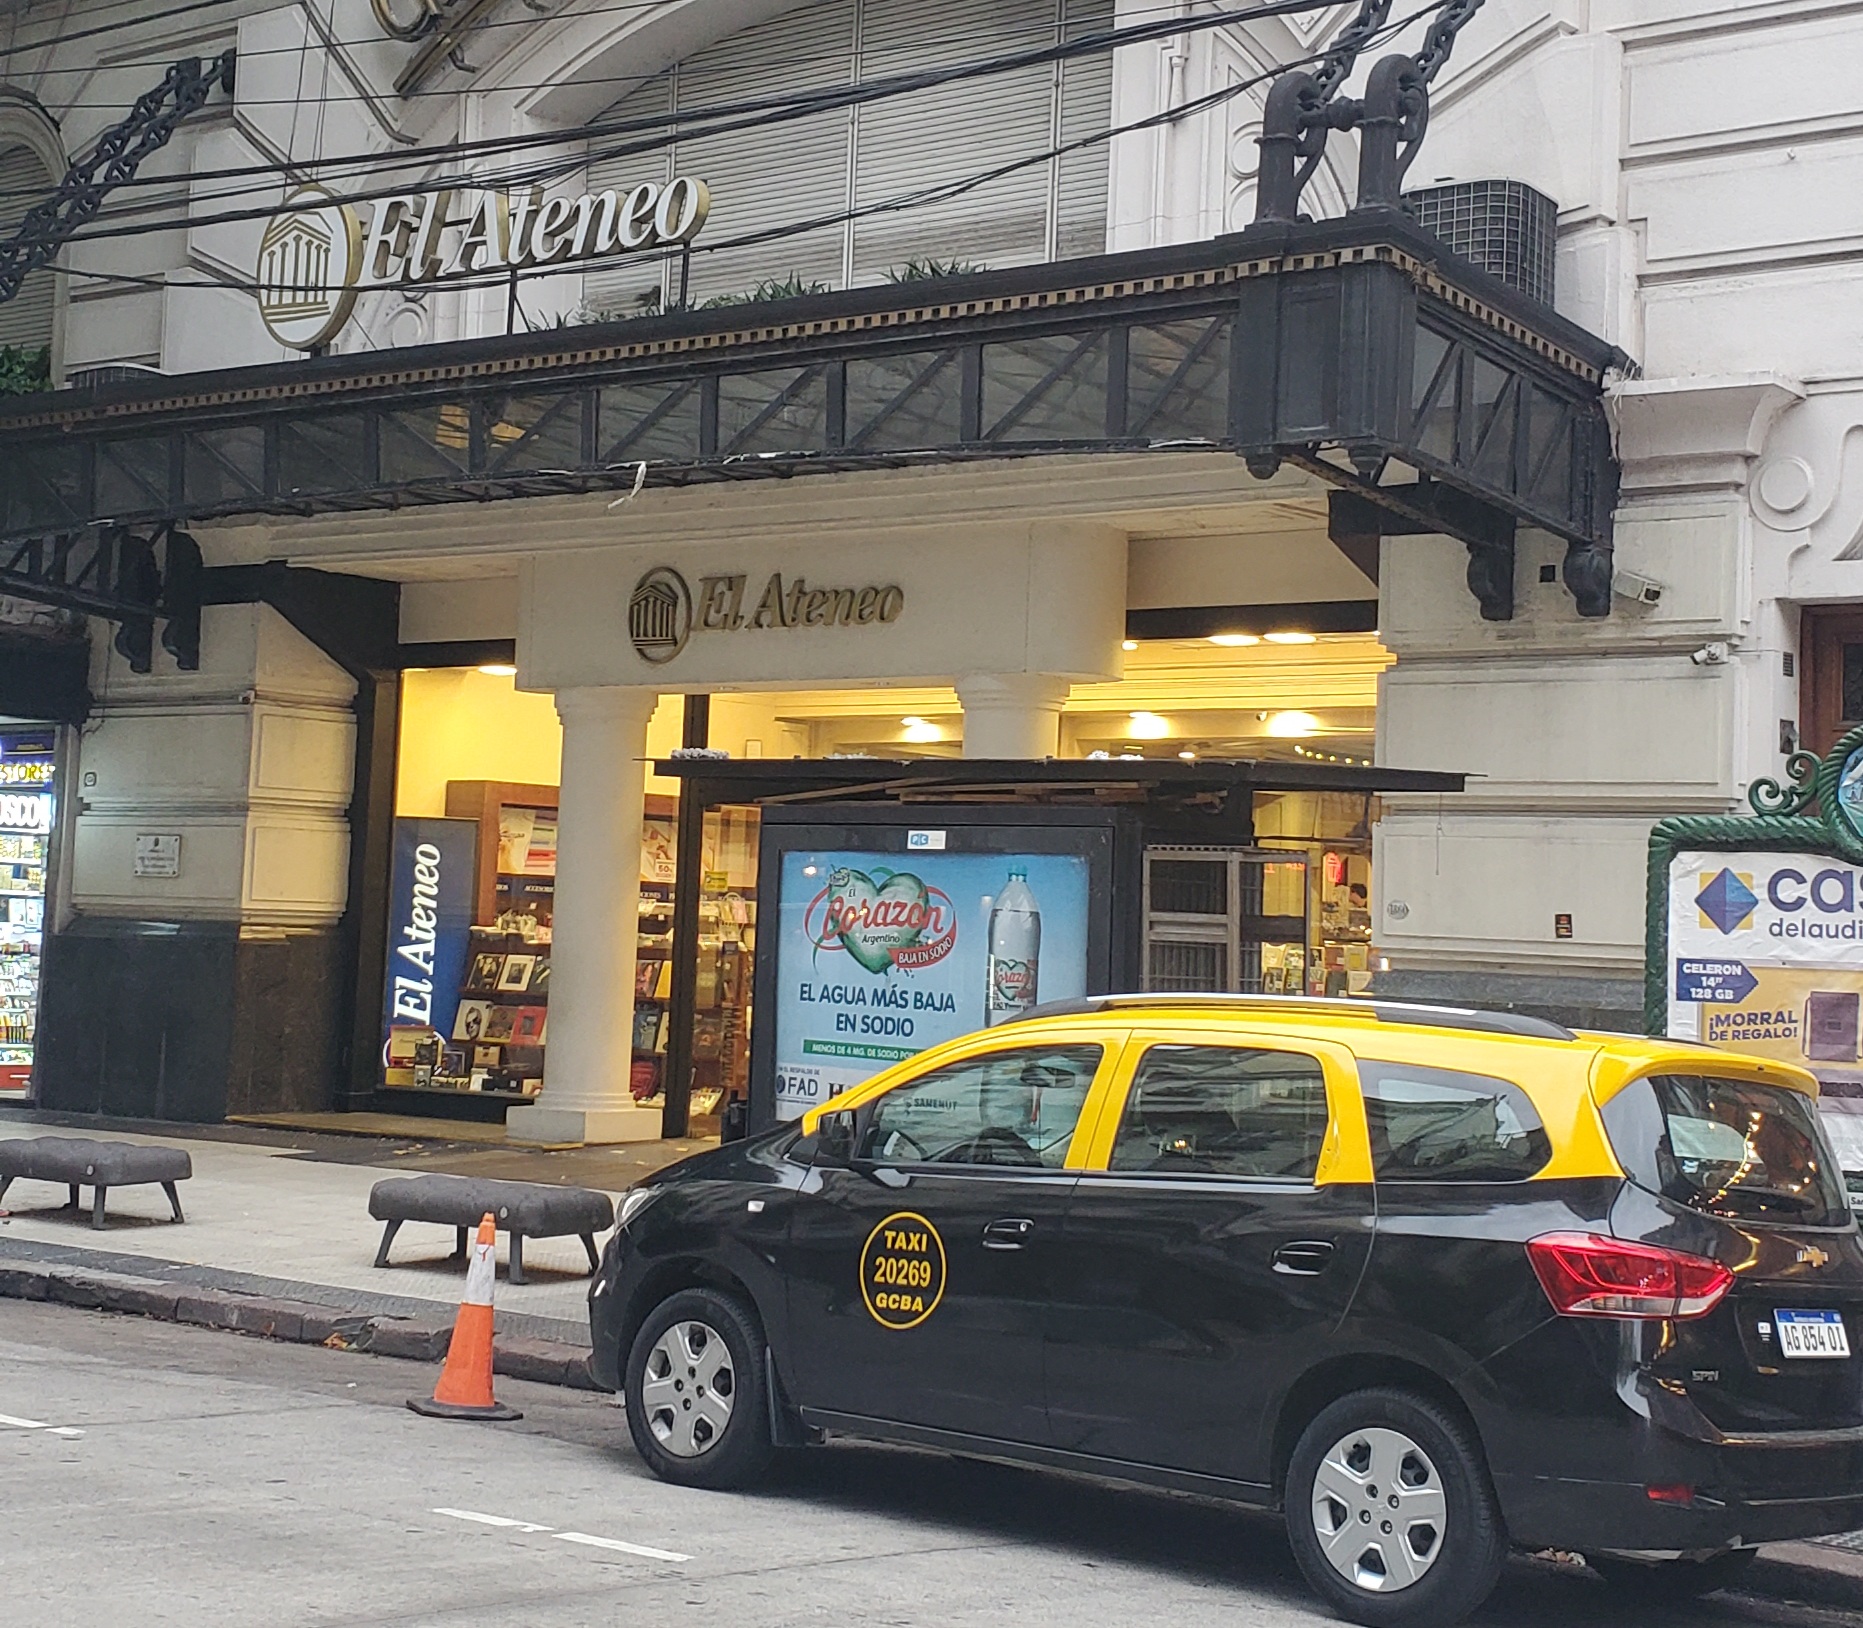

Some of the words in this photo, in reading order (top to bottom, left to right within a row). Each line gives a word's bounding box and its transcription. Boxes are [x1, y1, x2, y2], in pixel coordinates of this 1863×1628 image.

[358, 192, 447, 285] El
[443, 176, 709, 275] Ateneo
[690, 574, 747, 632] El
[745, 572, 904, 630] Ateneo
[1767, 868, 1863, 913] ca
[397, 843, 441, 975] Ateneo
[862, 934, 900, 946] Argentino
[899, 952, 917, 964] BAJA
[918, 950, 929, 963] EN
[930, 936, 952, 960] SODIO
[1682, 963, 1742, 976] CELERON
[393, 975, 433, 1026] El
[800, 983, 815, 1002] EL
[819, 984, 867, 1007] AGUA
[871, 983, 909, 1009] MÁS
[913, 991, 956, 1013] BAJA
[1690, 988, 1713, 999] 128
[1715, 989, 1734, 1000] GB
[836, 1012, 857, 1033] EN
[861, 1014, 914, 1038] SODIO
[1709, 1010, 1798, 1031] ¡MORRAL
[1709, 1031, 1729, 1042] DE
[1731, 1027, 1798, 1041] REGALO!
[812, 1043, 836, 1055] MENOS
[837, 1045, 846, 1056] DE
[847, 1046, 852, 1056] 4
[867, 1048, 877, 1058] DE
[877, 1049, 899, 1060] SODIO
[788, 1076, 818, 1097] FAD
[884, 1230, 928, 1252] TAXI
[873, 1256, 932, 1288] 20269
[875, 1292, 924, 1313] GCBA
[1784, 1325, 1801, 1351] AG
[1801, 1325, 1827, 1352] 854
